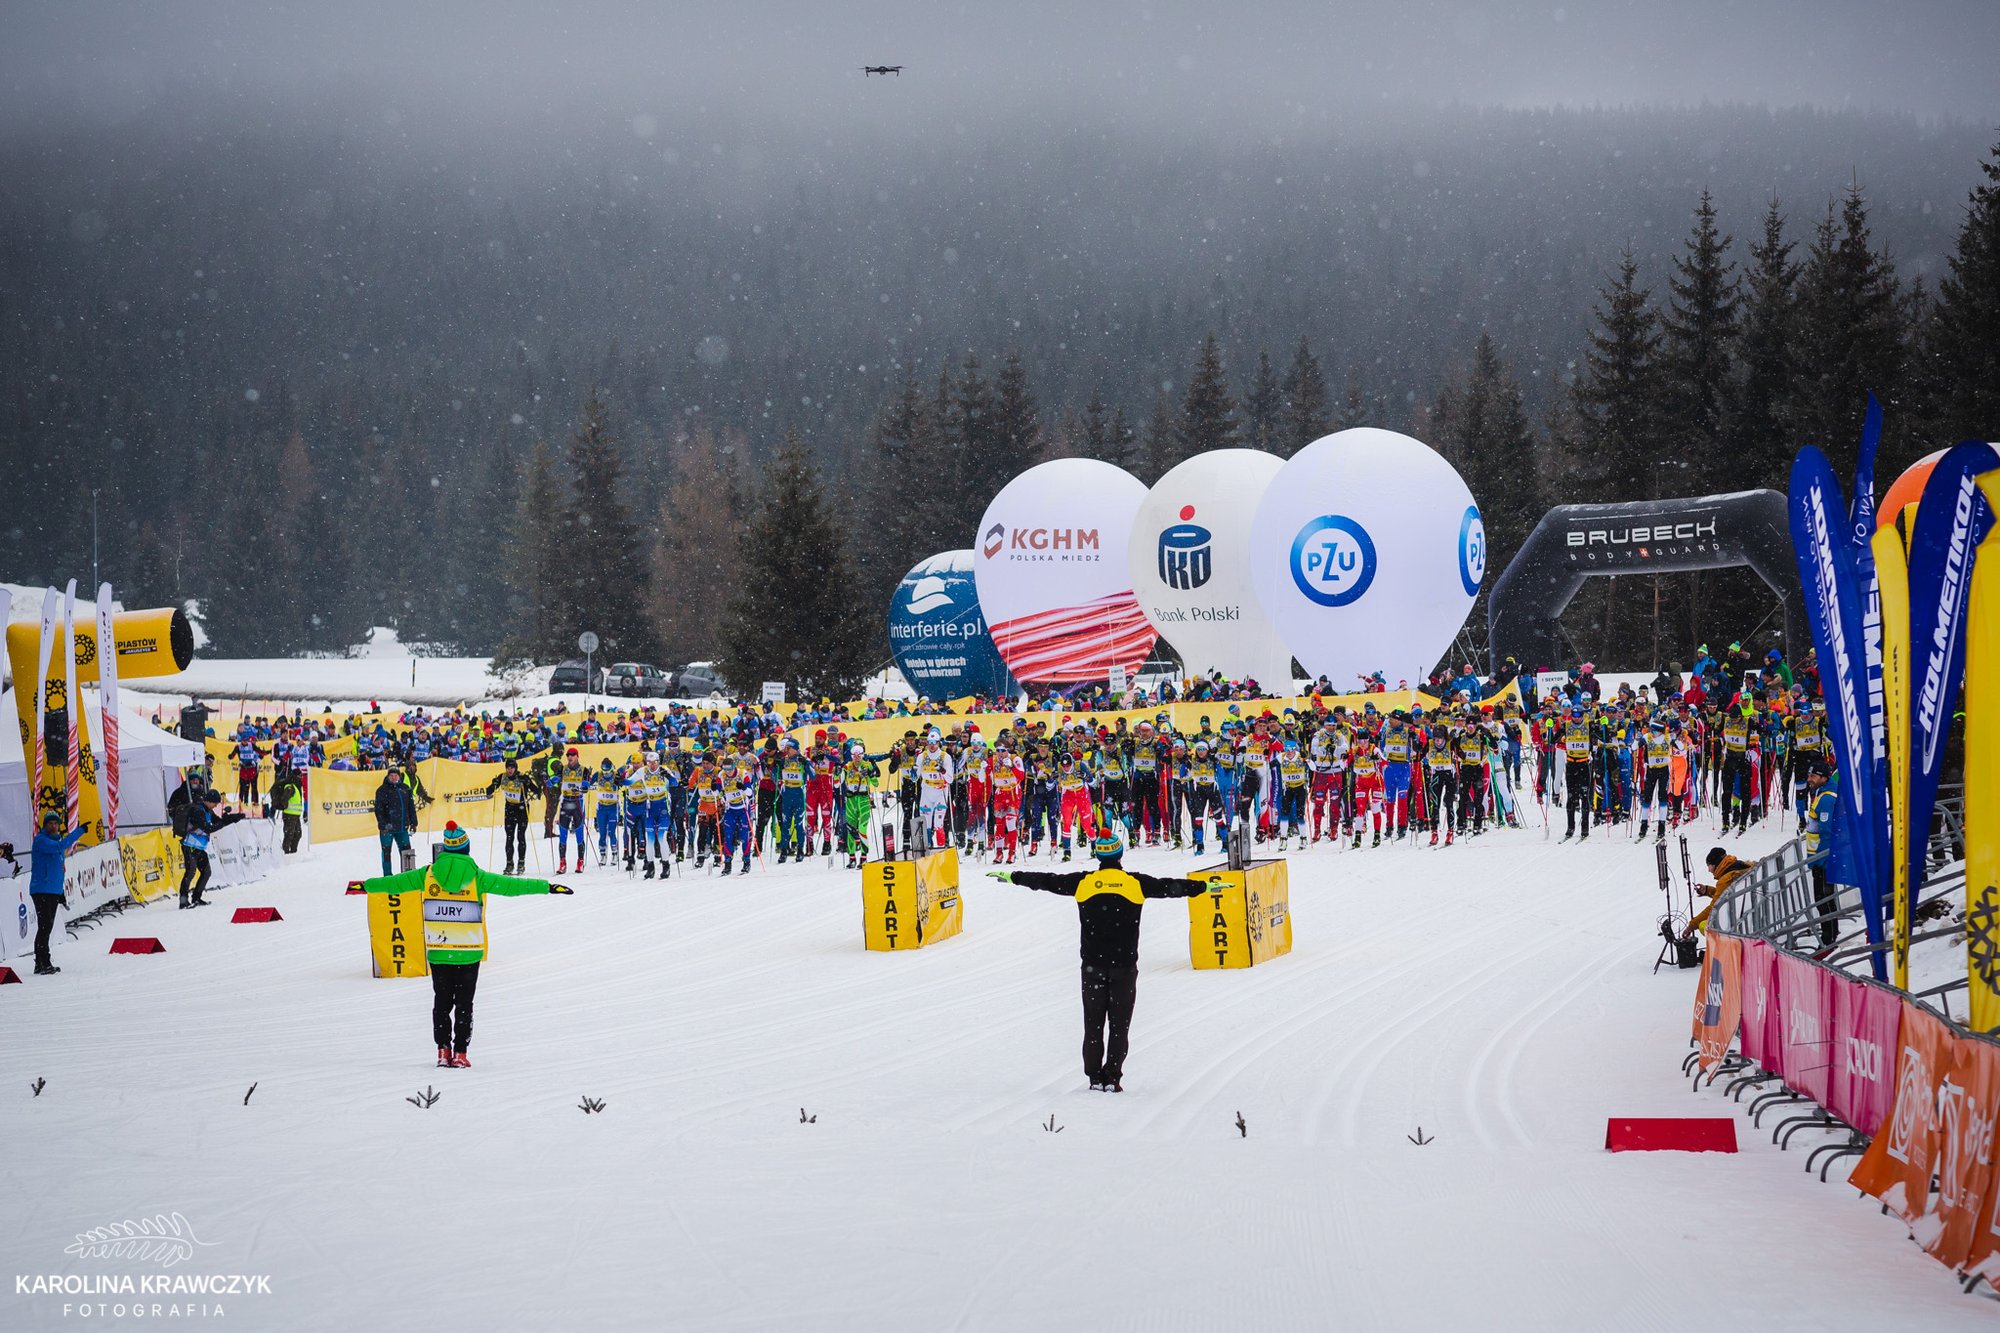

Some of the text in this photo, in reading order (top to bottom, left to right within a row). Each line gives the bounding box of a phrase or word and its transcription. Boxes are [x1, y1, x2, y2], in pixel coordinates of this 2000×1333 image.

[1011, 528, 1099, 550] KGHM
[1567, 519, 1716, 546] BRUBECK
[1852, 522, 1867, 546] TO
[1010, 554, 1054, 562] POLSKA
[1307, 542, 1355, 582] PZU
[1154, 605, 1240, 623] Bank Polski
[1919, 474, 1975, 733] HOLMENKOL
[890, 617, 981, 640] interferie.pl
[435, 906, 463, 916] JURY
[883, 865, 898, 948] START
[1209, 875, 1228, 966] START
[388, 893, 405, 975] START
